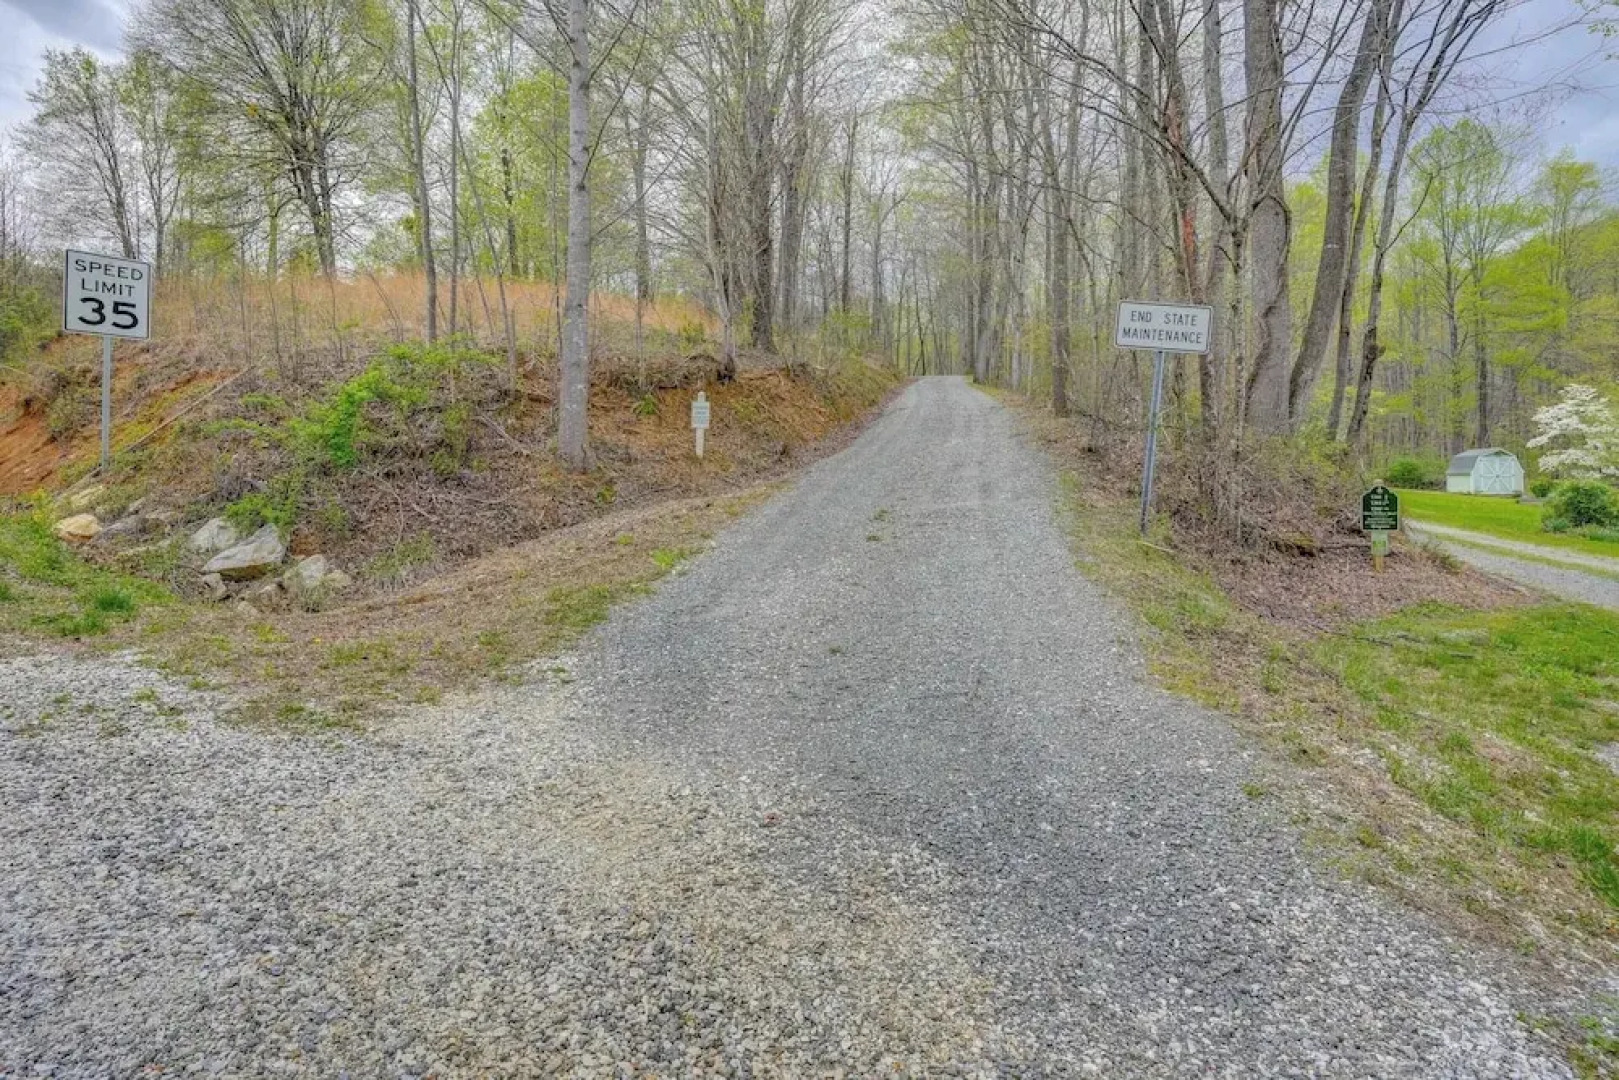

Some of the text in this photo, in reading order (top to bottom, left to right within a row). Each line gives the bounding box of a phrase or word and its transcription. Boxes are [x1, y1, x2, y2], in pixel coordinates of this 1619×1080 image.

[75, 259, 143, 280] SPEED
[81, 277, 136, 297] LIMIT
[78, 297, 139, 329] 35
[1130, 310, 1199, 326] END STATE
[1121, 326, 1204, 344] MAINTENANCE
